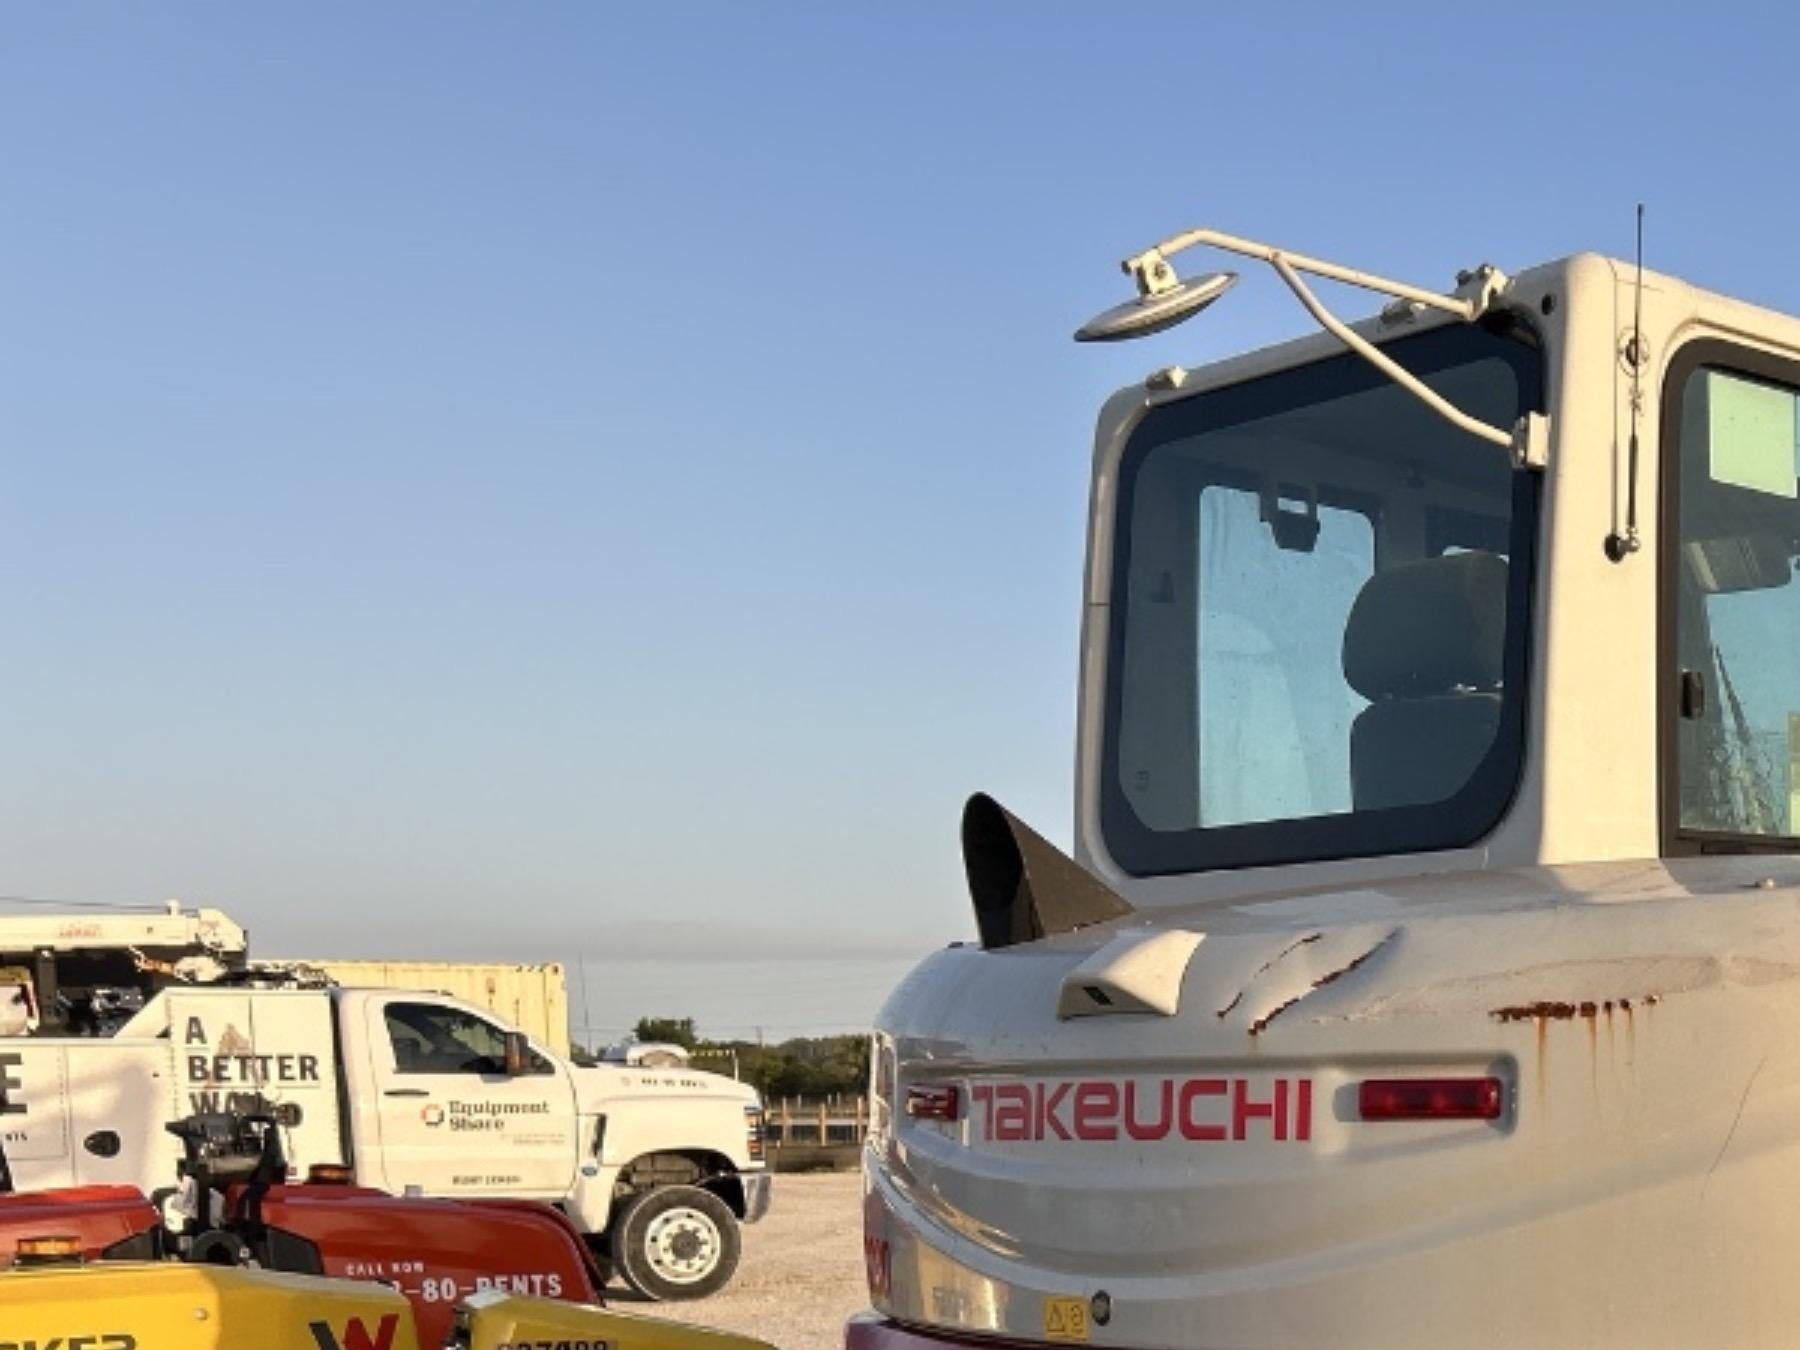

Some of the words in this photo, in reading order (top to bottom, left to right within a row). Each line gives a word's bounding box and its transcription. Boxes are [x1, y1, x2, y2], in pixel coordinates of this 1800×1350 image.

[185, 1016, 208, 1044] A
[188, 1055, 320, 1082] BETTER
[448, 1100, 550, 1117] Equipment
[972, 1080, 1312, 1141] TAKEUCHI
[449, 1117, 504, 1131] Share
[346, 1263, 385, 1276] CALL
[392, 1262, 424, 1273] NOW
